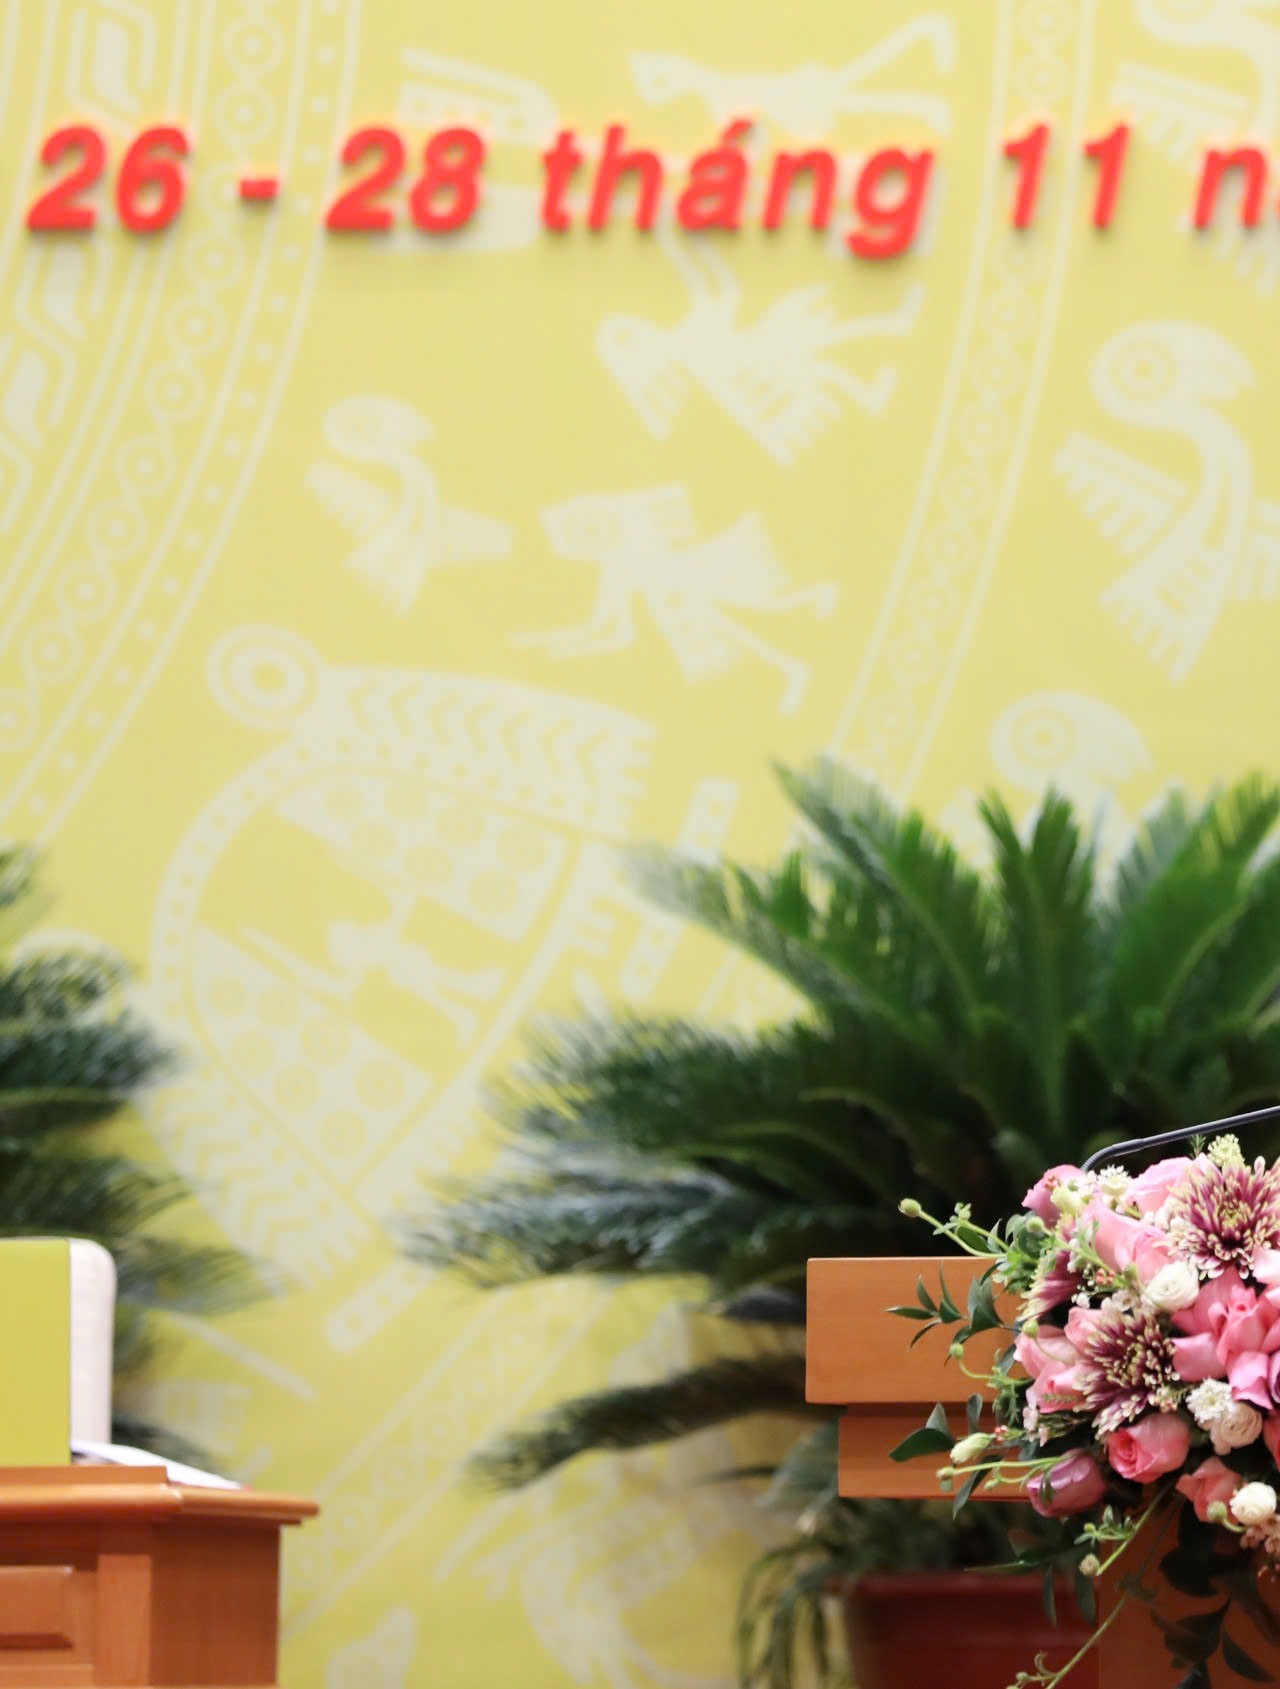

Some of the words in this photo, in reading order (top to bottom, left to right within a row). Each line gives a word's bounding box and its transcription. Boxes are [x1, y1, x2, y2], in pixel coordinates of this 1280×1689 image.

[25, 123, 191, 234] 26
[238, 176, 281, 201] -
[324, 125, 487, 234] 28
[541, 119, 935, 260] tháng
[1003, 122, 1130, 229] 11
